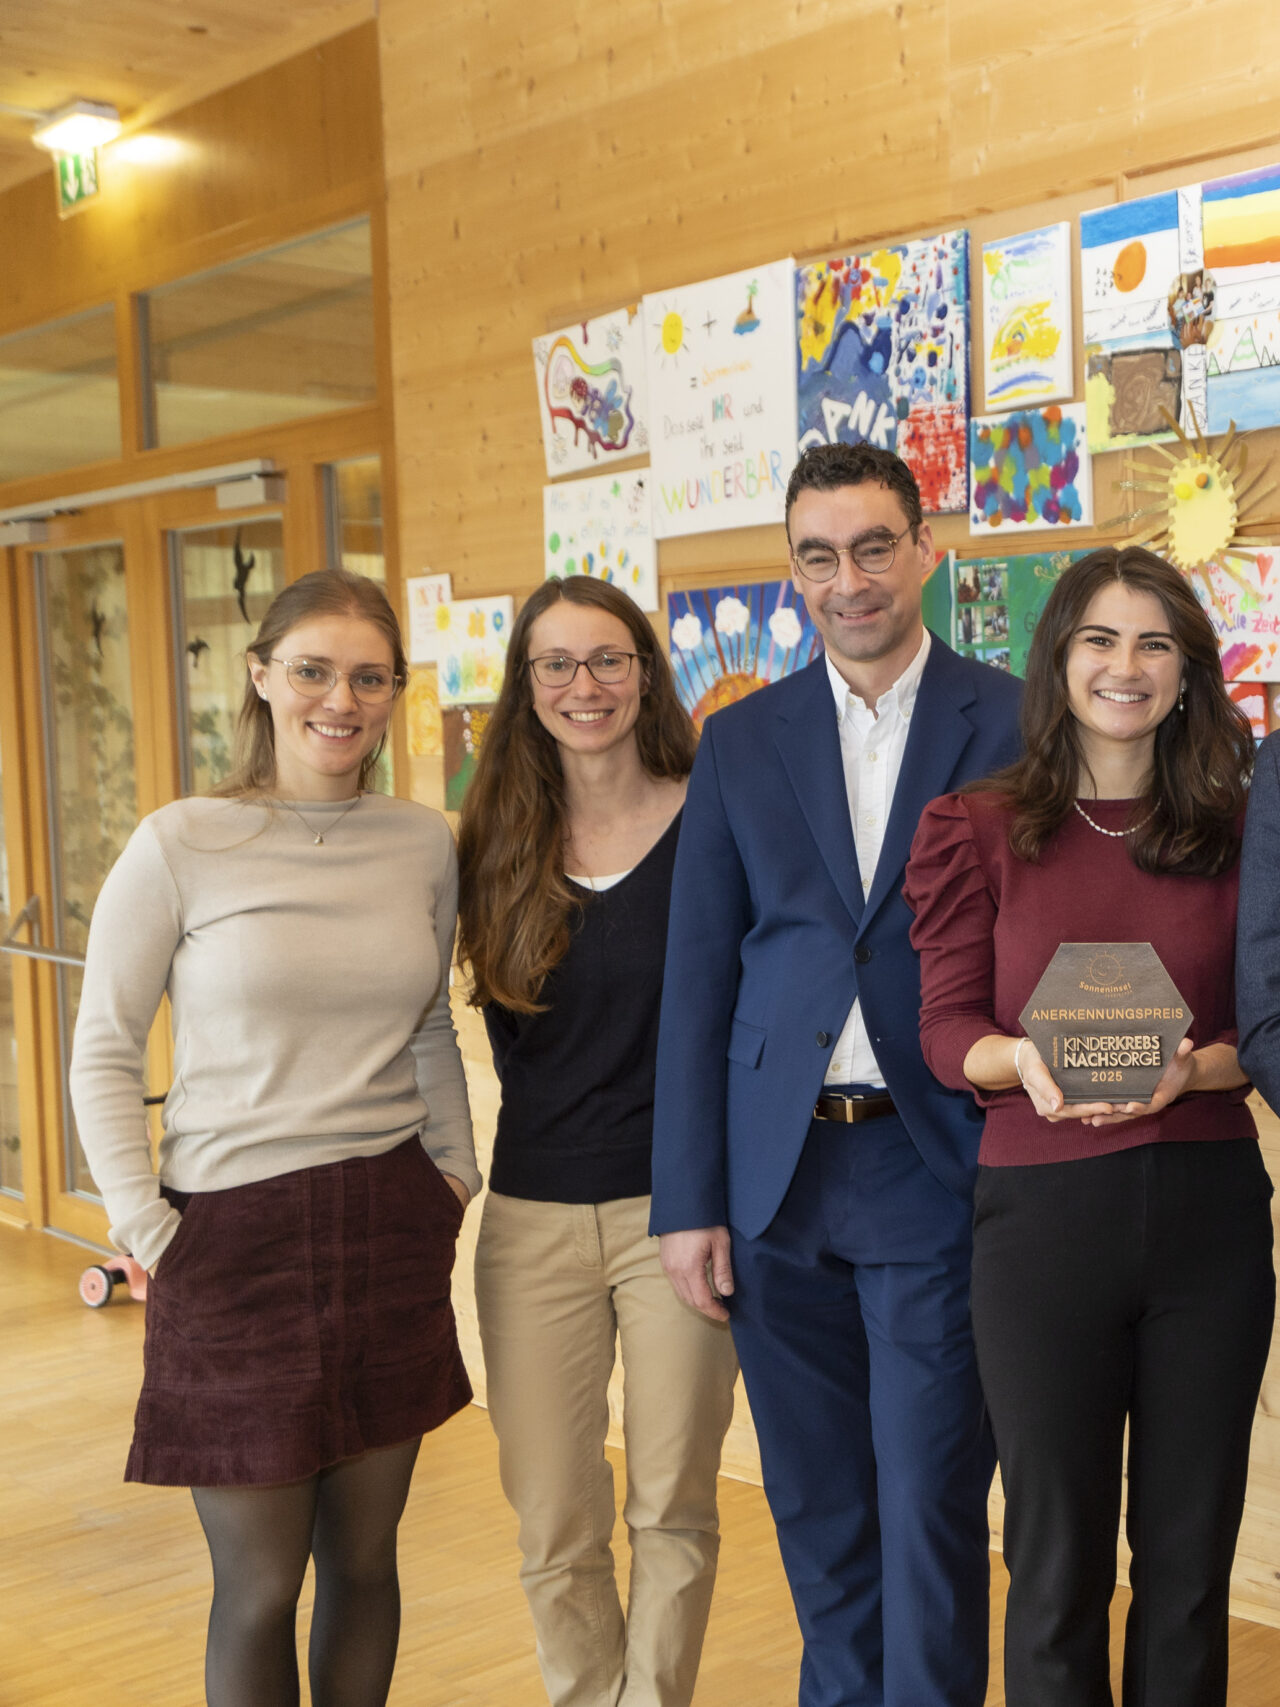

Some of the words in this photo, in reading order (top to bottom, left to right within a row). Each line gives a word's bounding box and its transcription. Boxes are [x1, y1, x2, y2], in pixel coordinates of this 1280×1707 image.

[1187, 344, 1207, 432] DANKE
[711, 393, 735, 422] IHR
[743, 396, 764, 418] und
[660, 449, 787, 515] WUNDERBAR
[1251, 611, 1280, 635] Zeit
[1079, 980, 1132, 994] Sonneninsel
[1031, 1007, 1184, 1021] ANERKENNUNGSPREIS
[1063, 1035, 1161, 1052] KINDERKREBS
[1063, 1052, 1162, 1069] NACHSORGE
[1091, 1070, 1123, 1082] 2025
